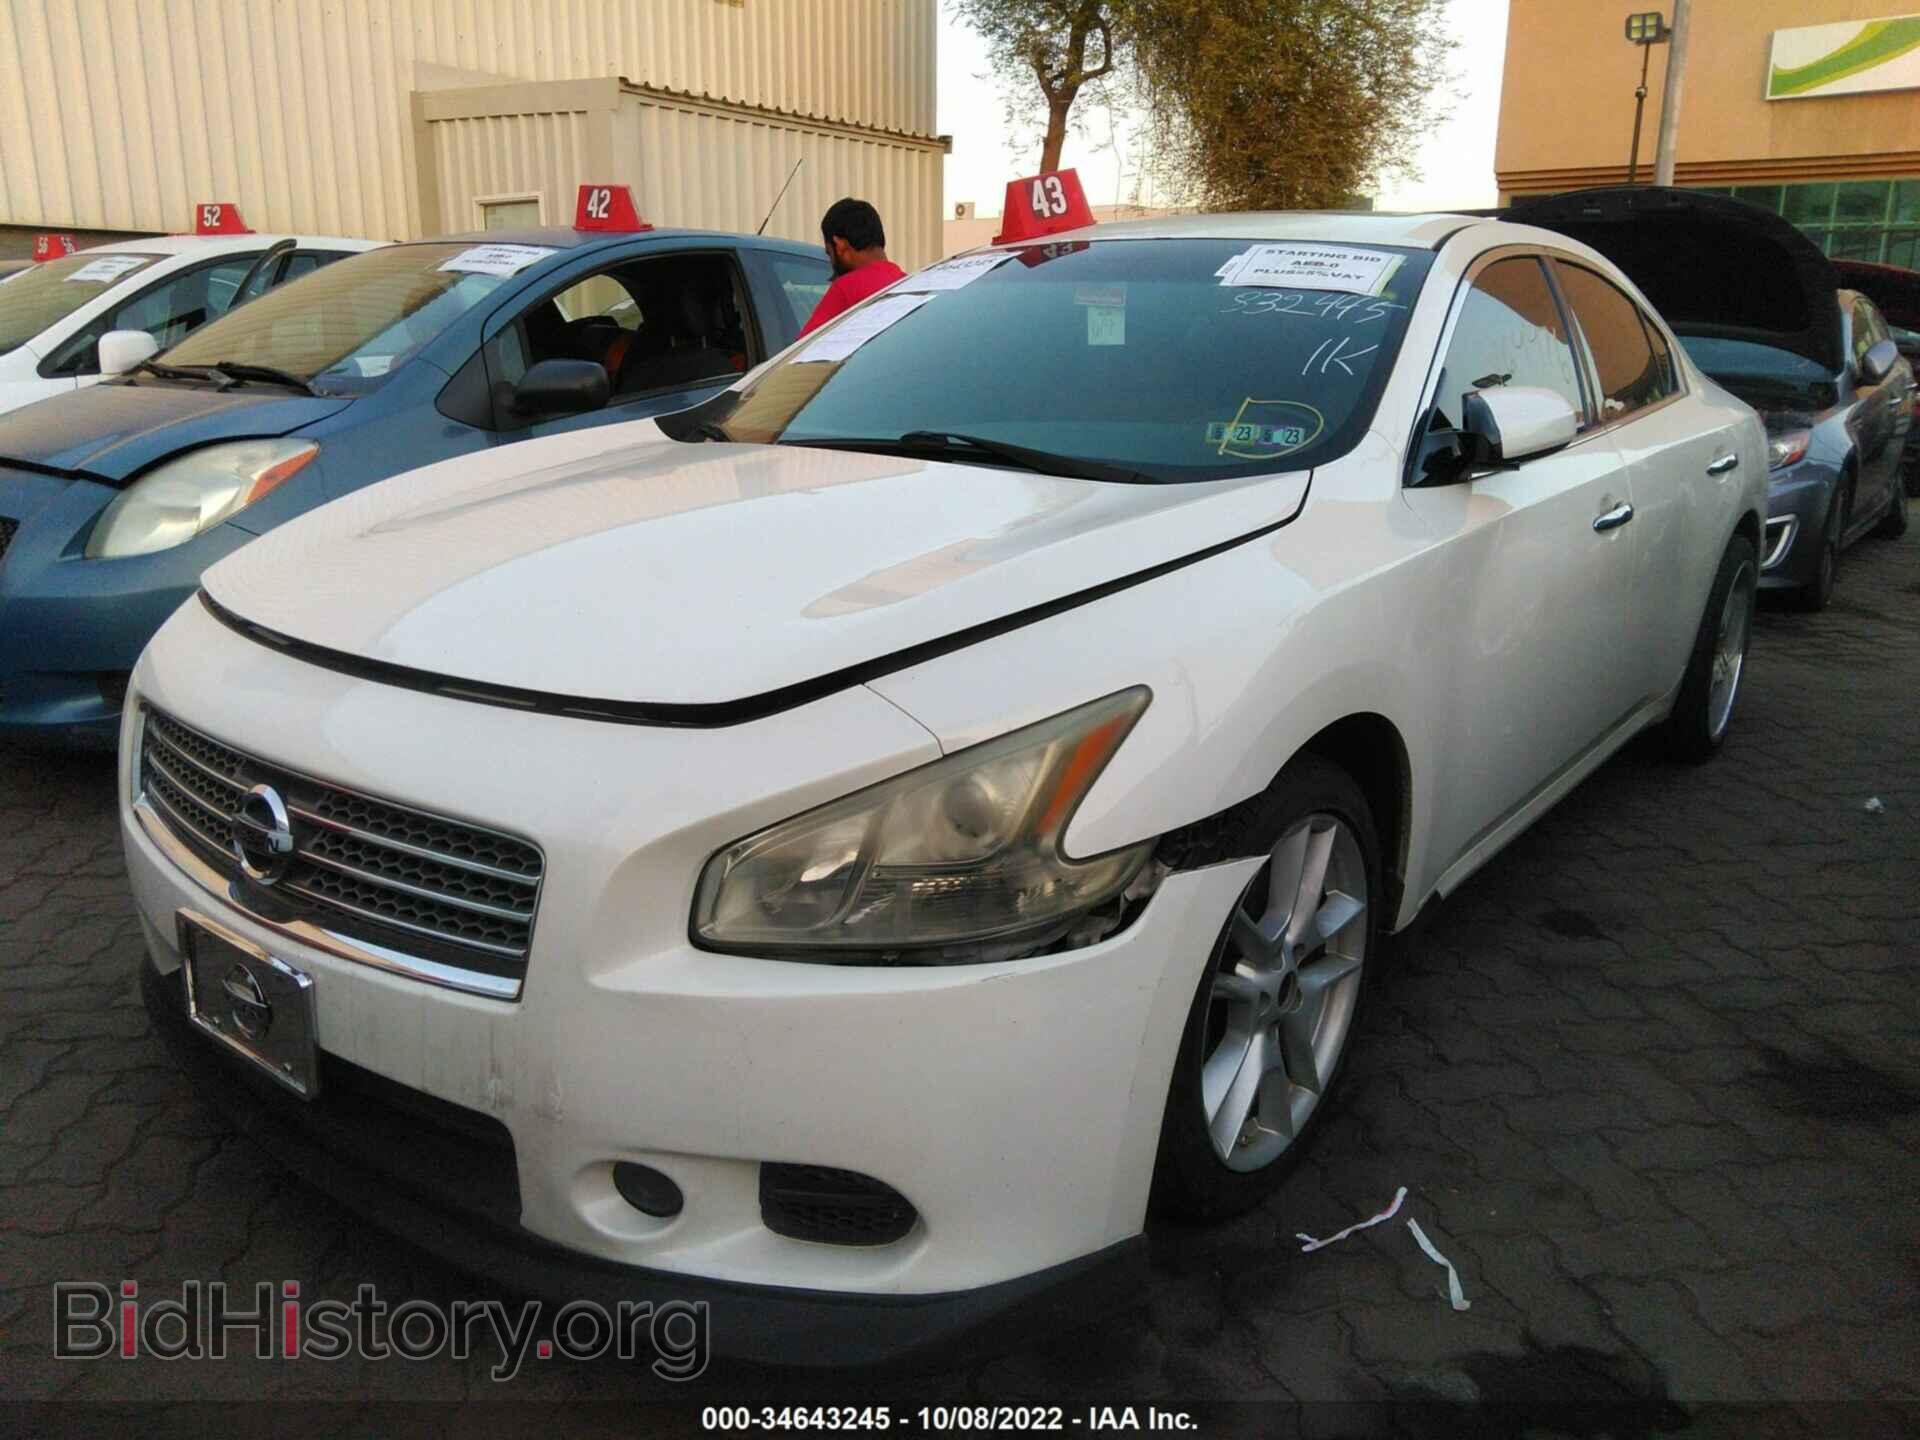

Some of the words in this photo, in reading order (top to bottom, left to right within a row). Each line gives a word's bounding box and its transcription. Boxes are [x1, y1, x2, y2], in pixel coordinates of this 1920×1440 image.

[587, 189, 611, 219] 42
[1032, 175, 1067, 217] 43
[203, 205, 221, 227] 52
[1265, 249, 1347, 260] STARTING
[1352, 255, 1382, 263] BID
[1236, 426, 1252, 441] 23
[1284, 428, 1300, 444] 23
